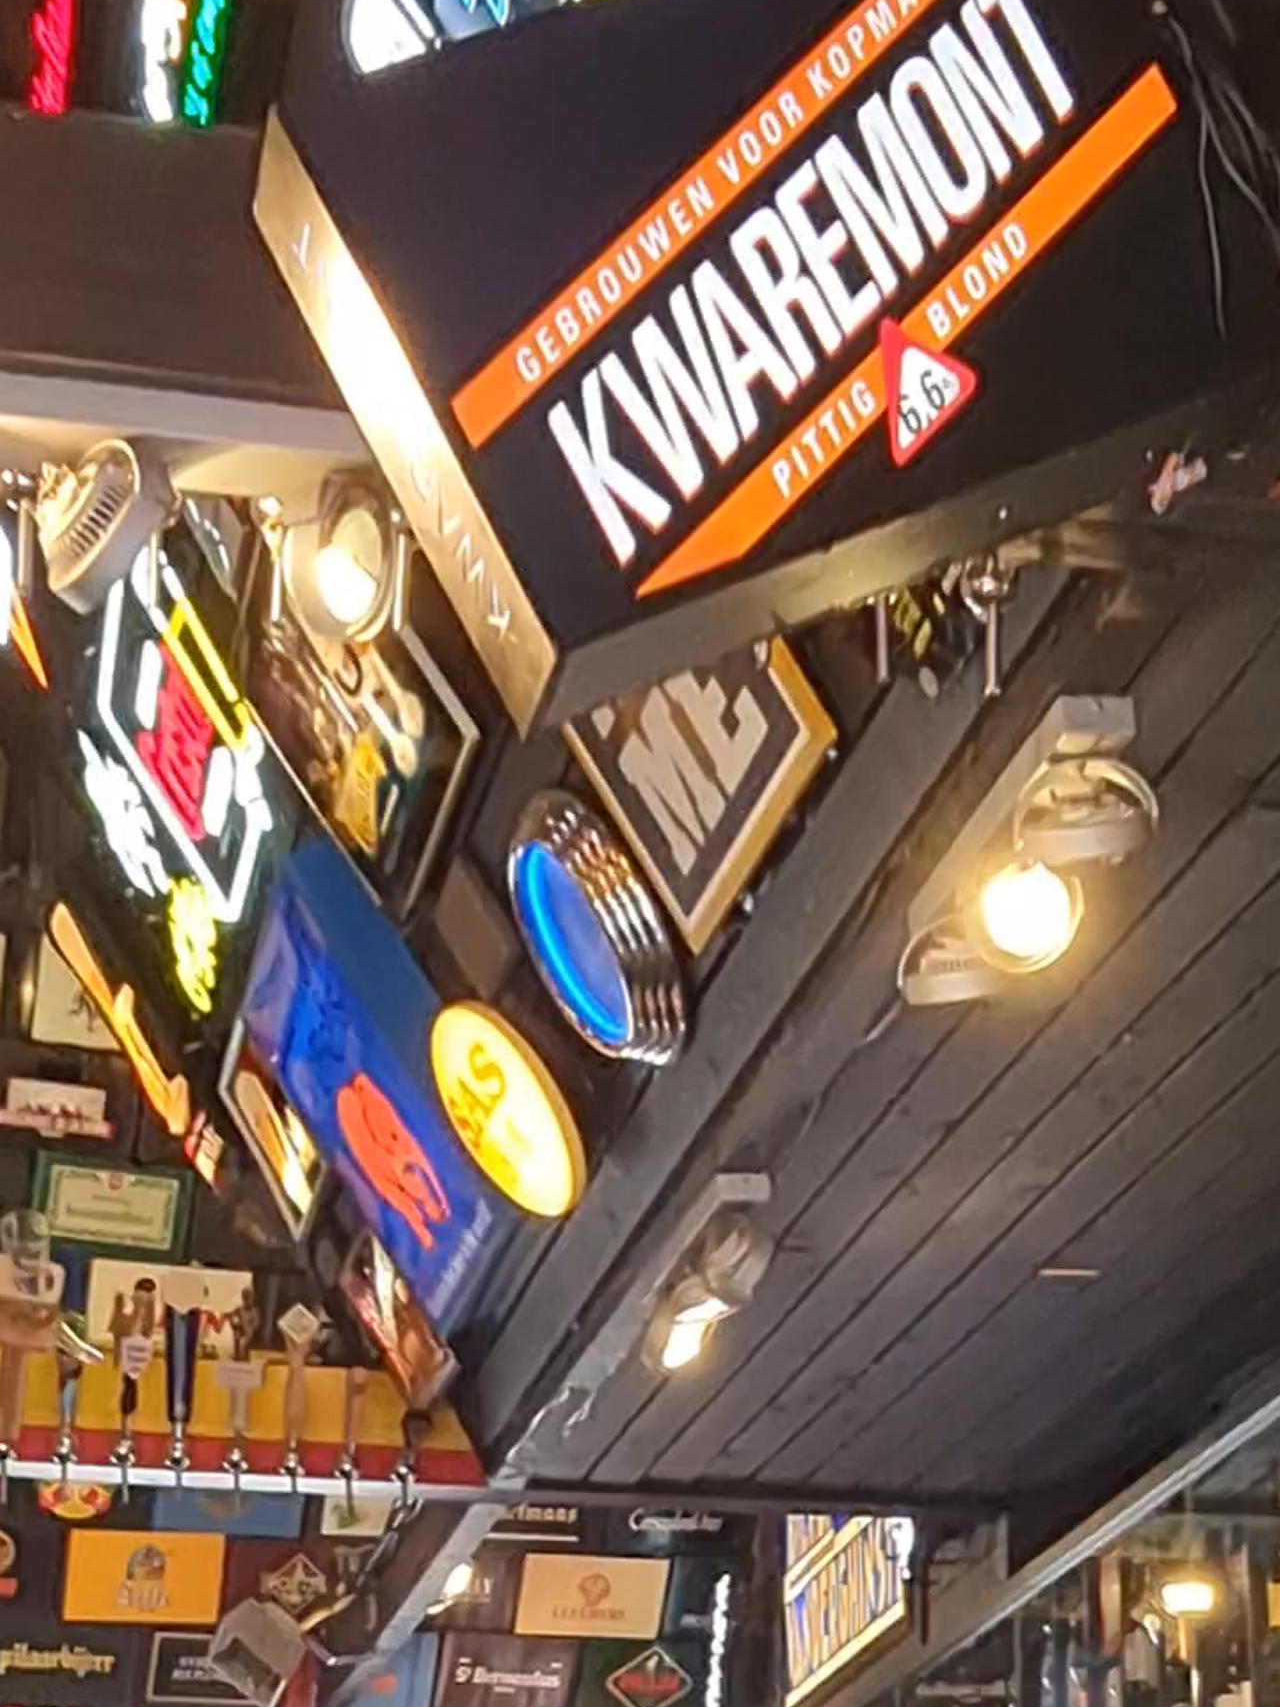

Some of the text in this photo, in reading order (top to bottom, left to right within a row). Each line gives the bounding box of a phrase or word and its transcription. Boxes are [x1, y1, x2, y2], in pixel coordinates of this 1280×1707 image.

[515, 177, 715, 385] GEBROUWEN
[717, 90, 807, 186] VOOR
[770, 222, 1029, 499] PITTIG BLOND
[592, 643, 770, 877] ME
